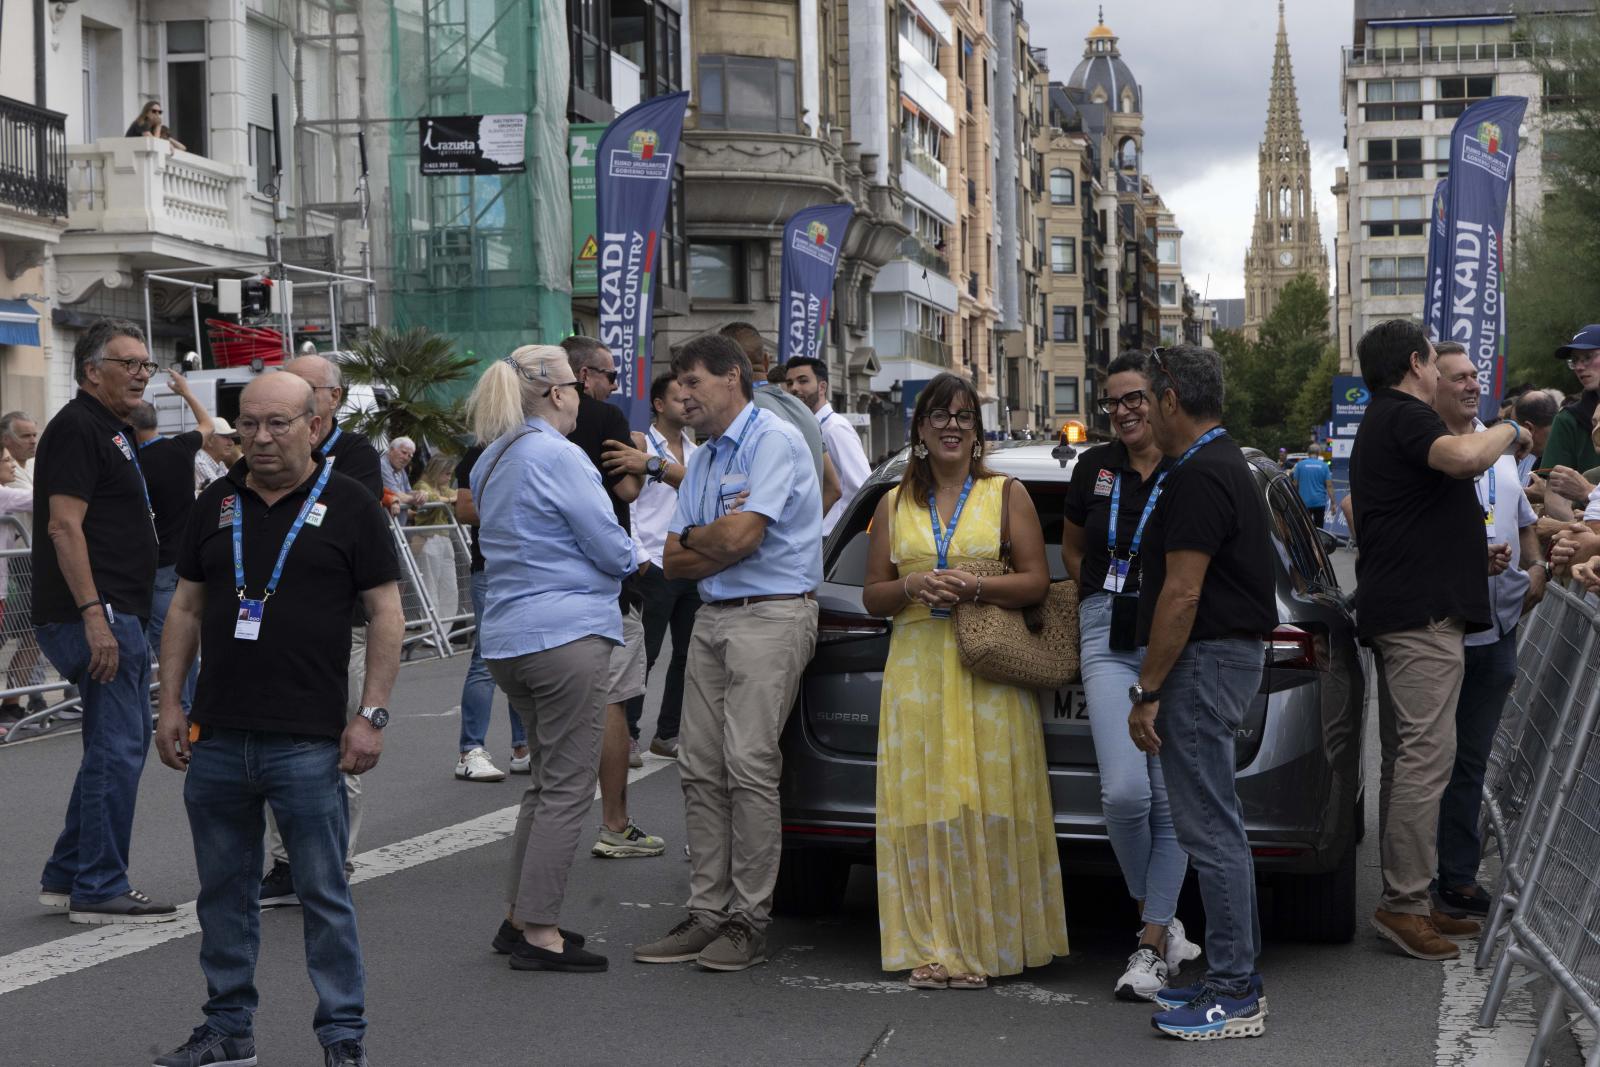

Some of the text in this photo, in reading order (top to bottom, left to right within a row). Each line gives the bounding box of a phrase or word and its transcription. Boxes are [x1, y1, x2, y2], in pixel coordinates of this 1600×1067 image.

[624, 231, 644, 398] BASQUE COUNTRY
[1452, 220, 1483, 361] SKADI
[1484, 224, 1499, 315] COUNTRY
[816, 712, 869, 721] SUPERB
